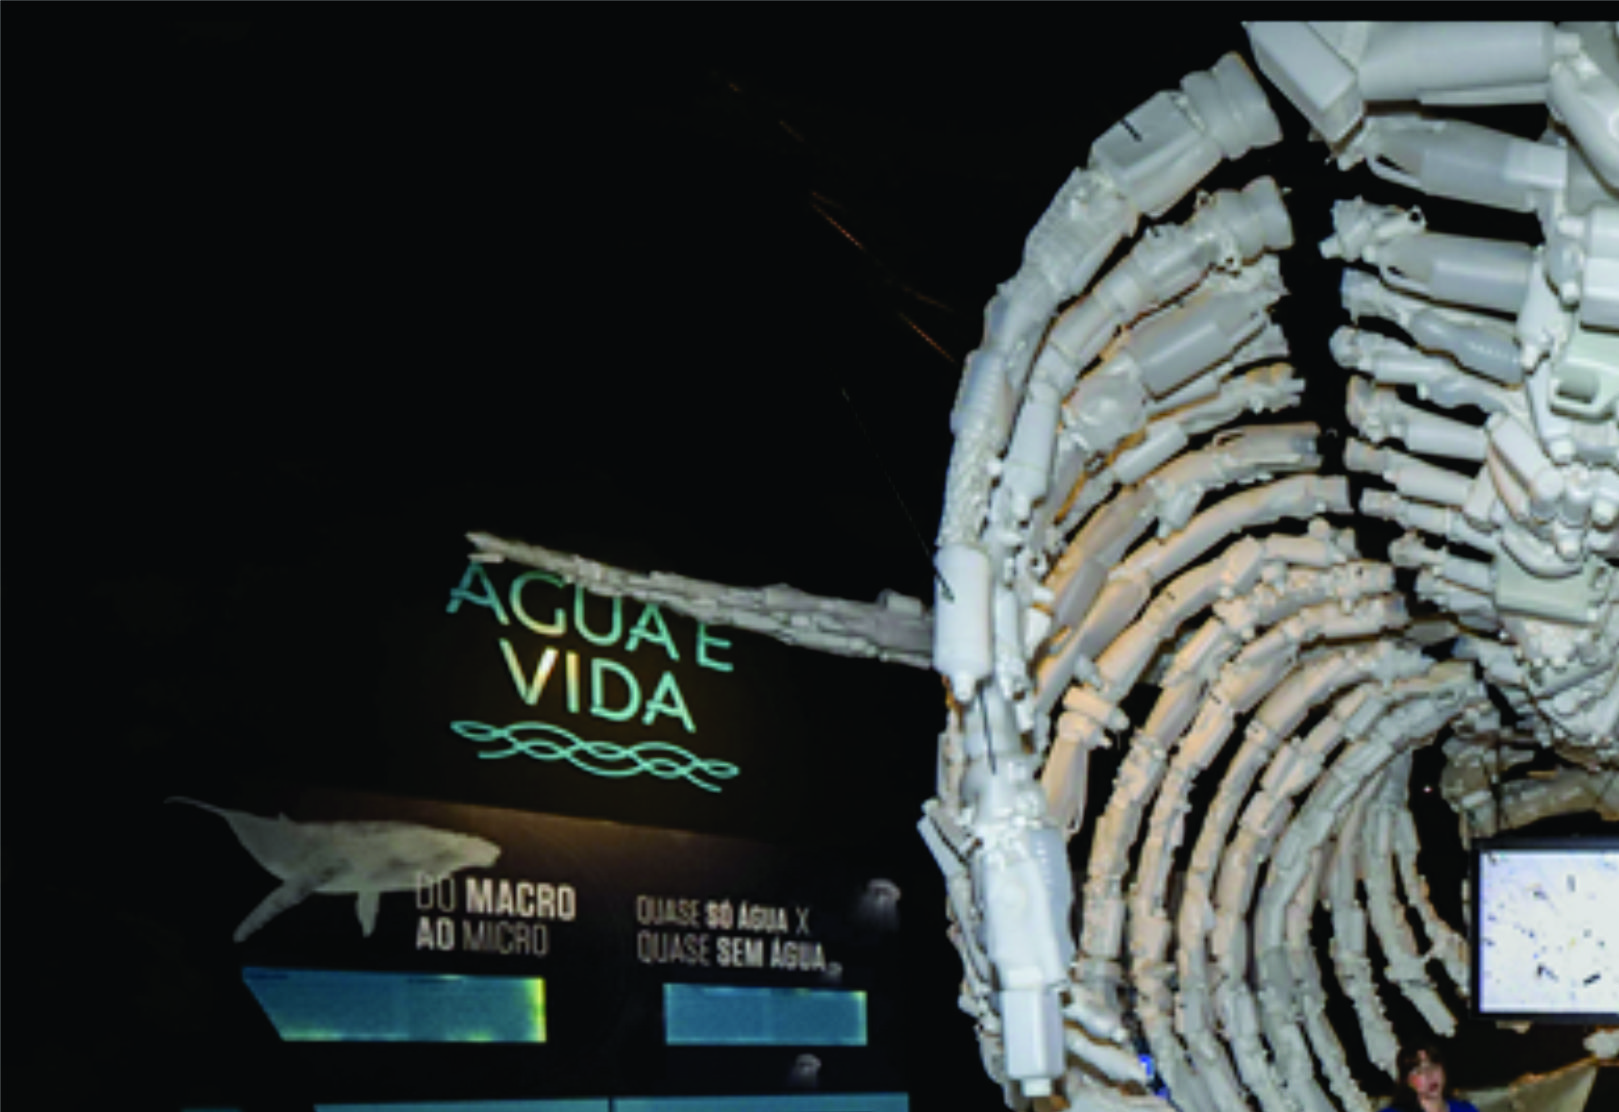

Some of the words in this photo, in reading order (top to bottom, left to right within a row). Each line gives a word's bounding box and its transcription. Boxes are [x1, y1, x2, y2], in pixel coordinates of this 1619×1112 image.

[500, 637, 697, 733] VIDA
[416, 871, 455, 912] DO
[465, 876, 577, 921] MACRO
[636, 895, 700, 928] QUASE
[796, 907, 810, 935] X
[415, 916, 455, 950] AO
[462, 919, 549, 956] MICRO
[637, 929, 711, 967] QUASE
[716, 936, 764, 968] SEM
